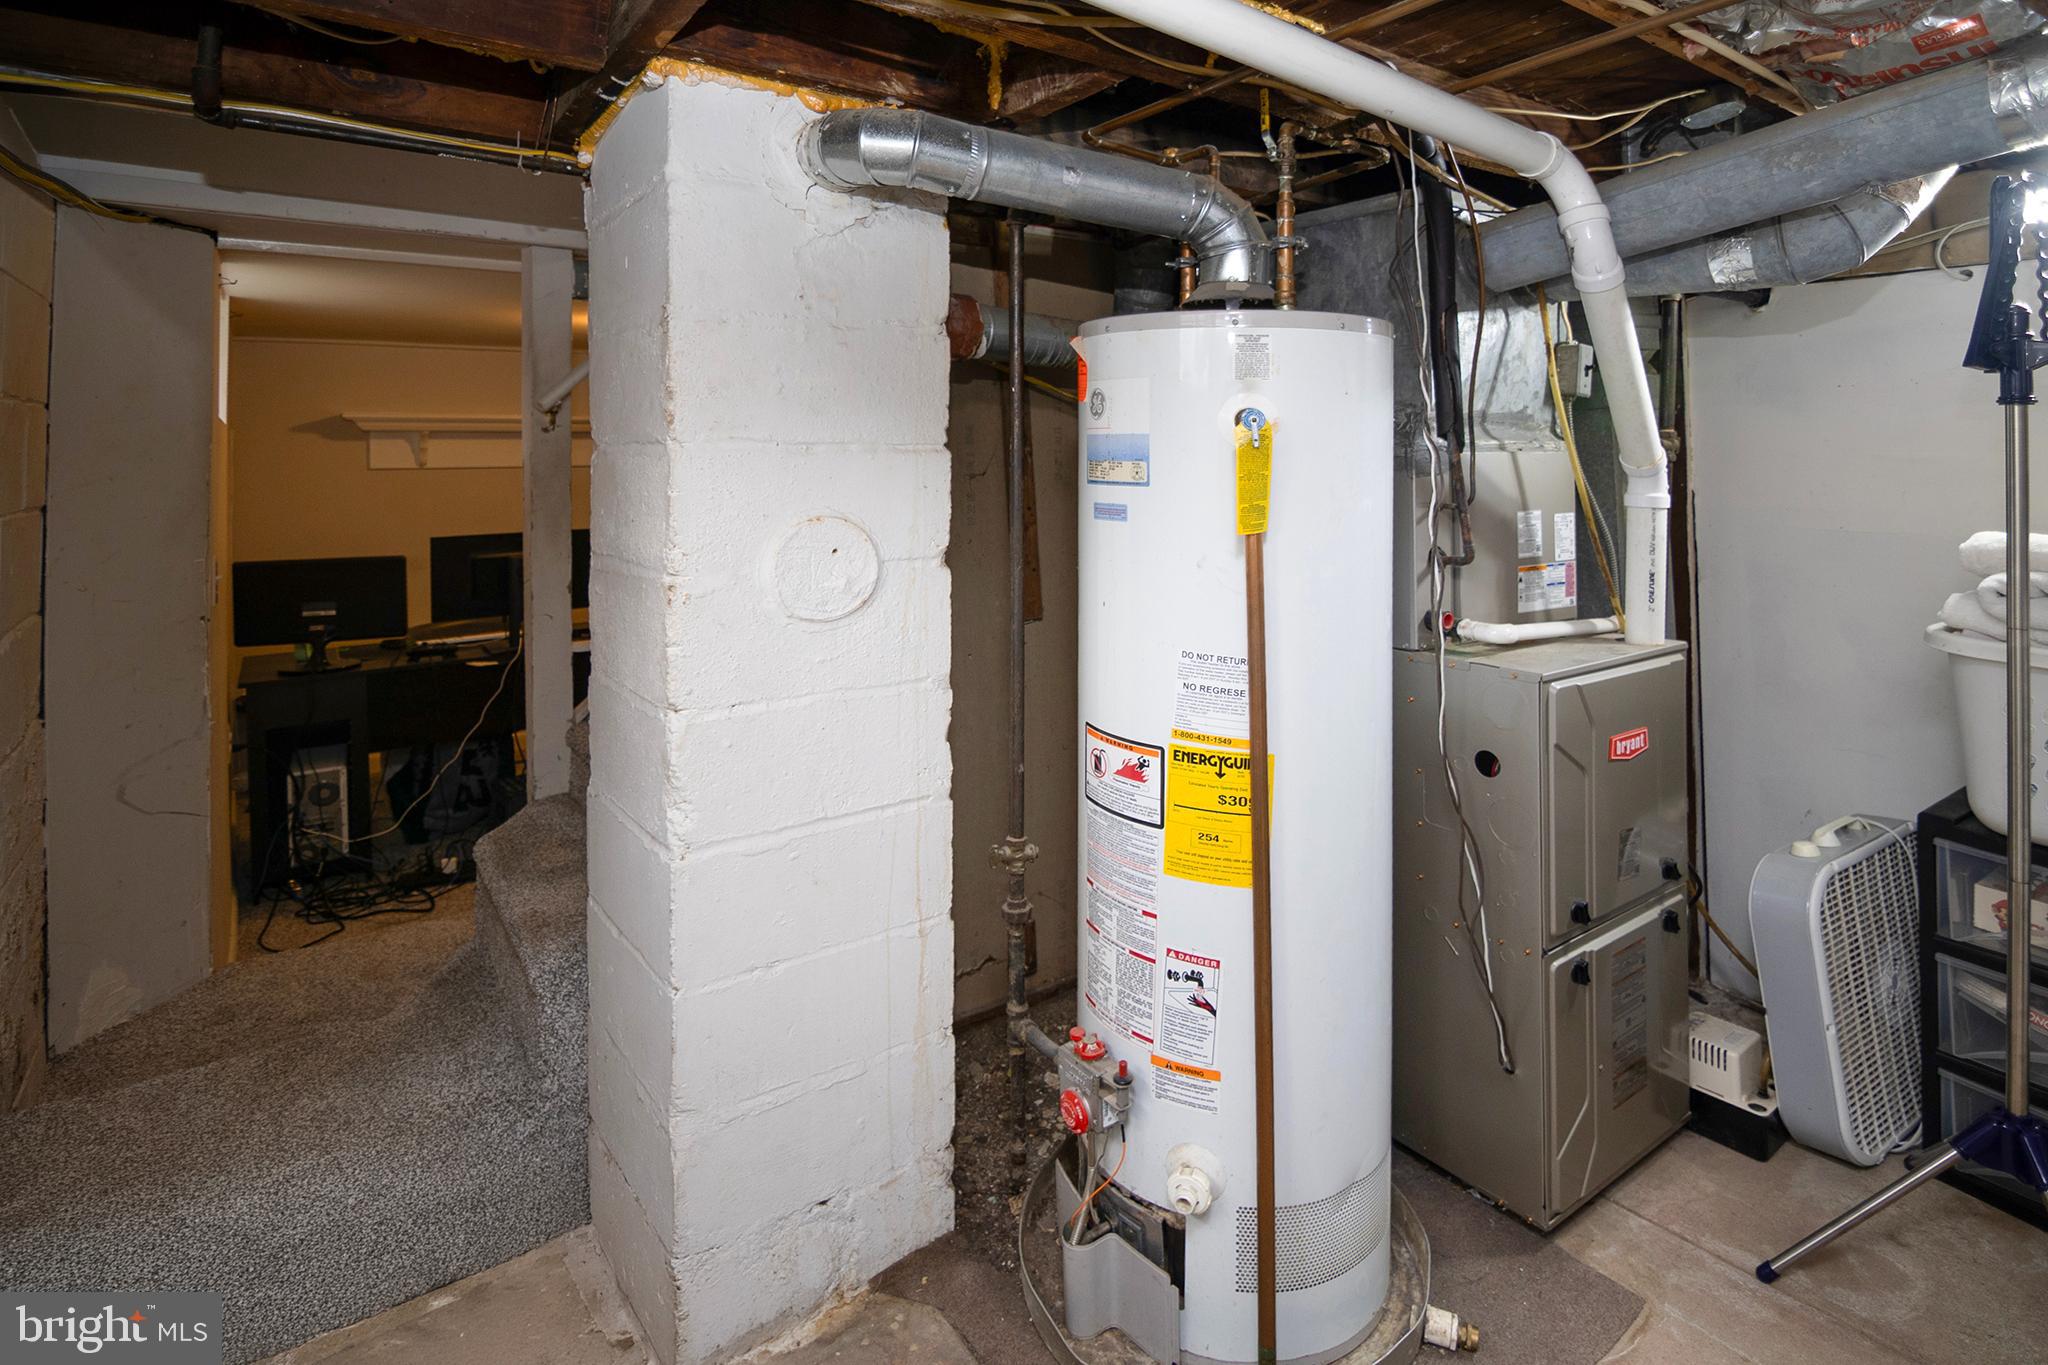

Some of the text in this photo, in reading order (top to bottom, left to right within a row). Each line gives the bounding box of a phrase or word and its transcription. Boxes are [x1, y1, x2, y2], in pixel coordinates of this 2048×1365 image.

[1181, 650, 1248, 666] DO NOT RETUR
[1182, 682, 1246, 698] NO REGRESE
[1173, 730, 1232, 745] 1-800-431-1549
[1616, 733, 1645, 755] bryant
[1197, 832, 1220, 843] 254
[1178, 953, 1218, 968] DANGER
[1174, 1064, 1205, 1078] WARNING
